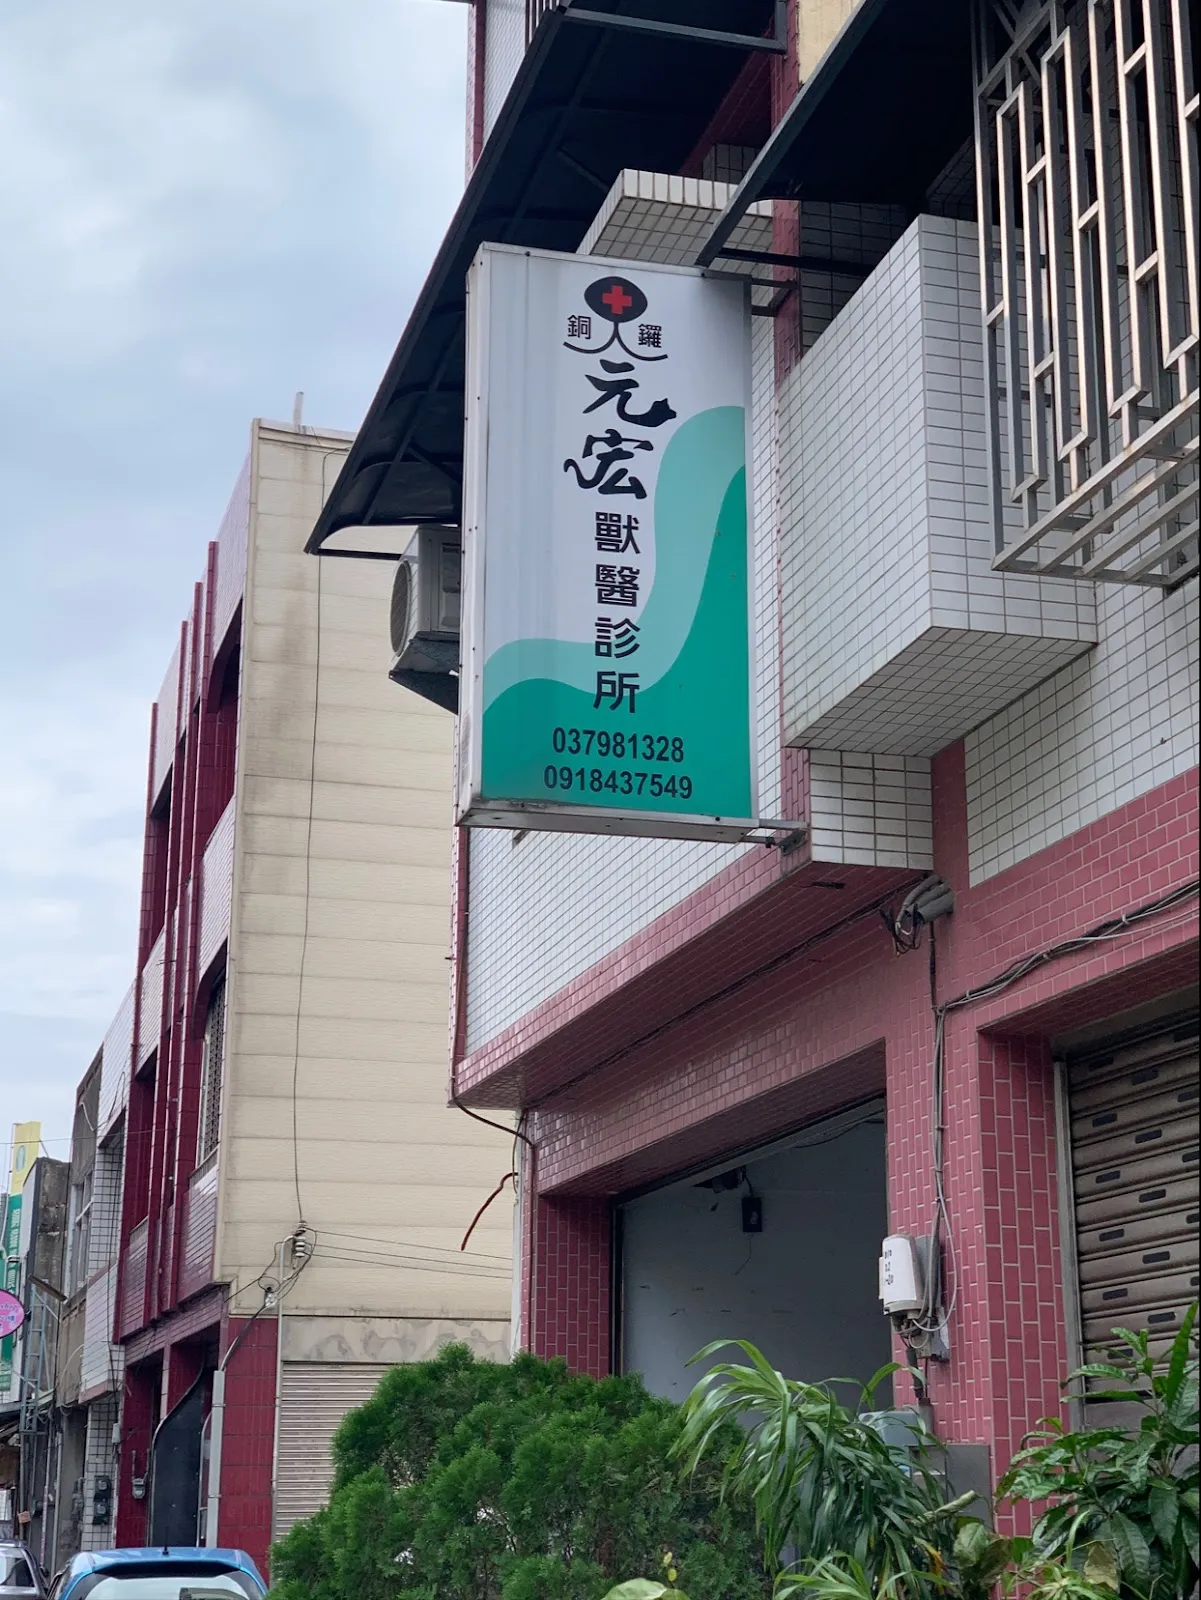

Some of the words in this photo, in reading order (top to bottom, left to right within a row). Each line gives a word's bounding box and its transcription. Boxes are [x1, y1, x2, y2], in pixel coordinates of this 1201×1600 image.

[567, 315, 591, 340] 銅
[638, 323, 662, 348] 鑼
[552, 727, 684, 763] 037981328
[543, 765, 693, 799] 0918437549
